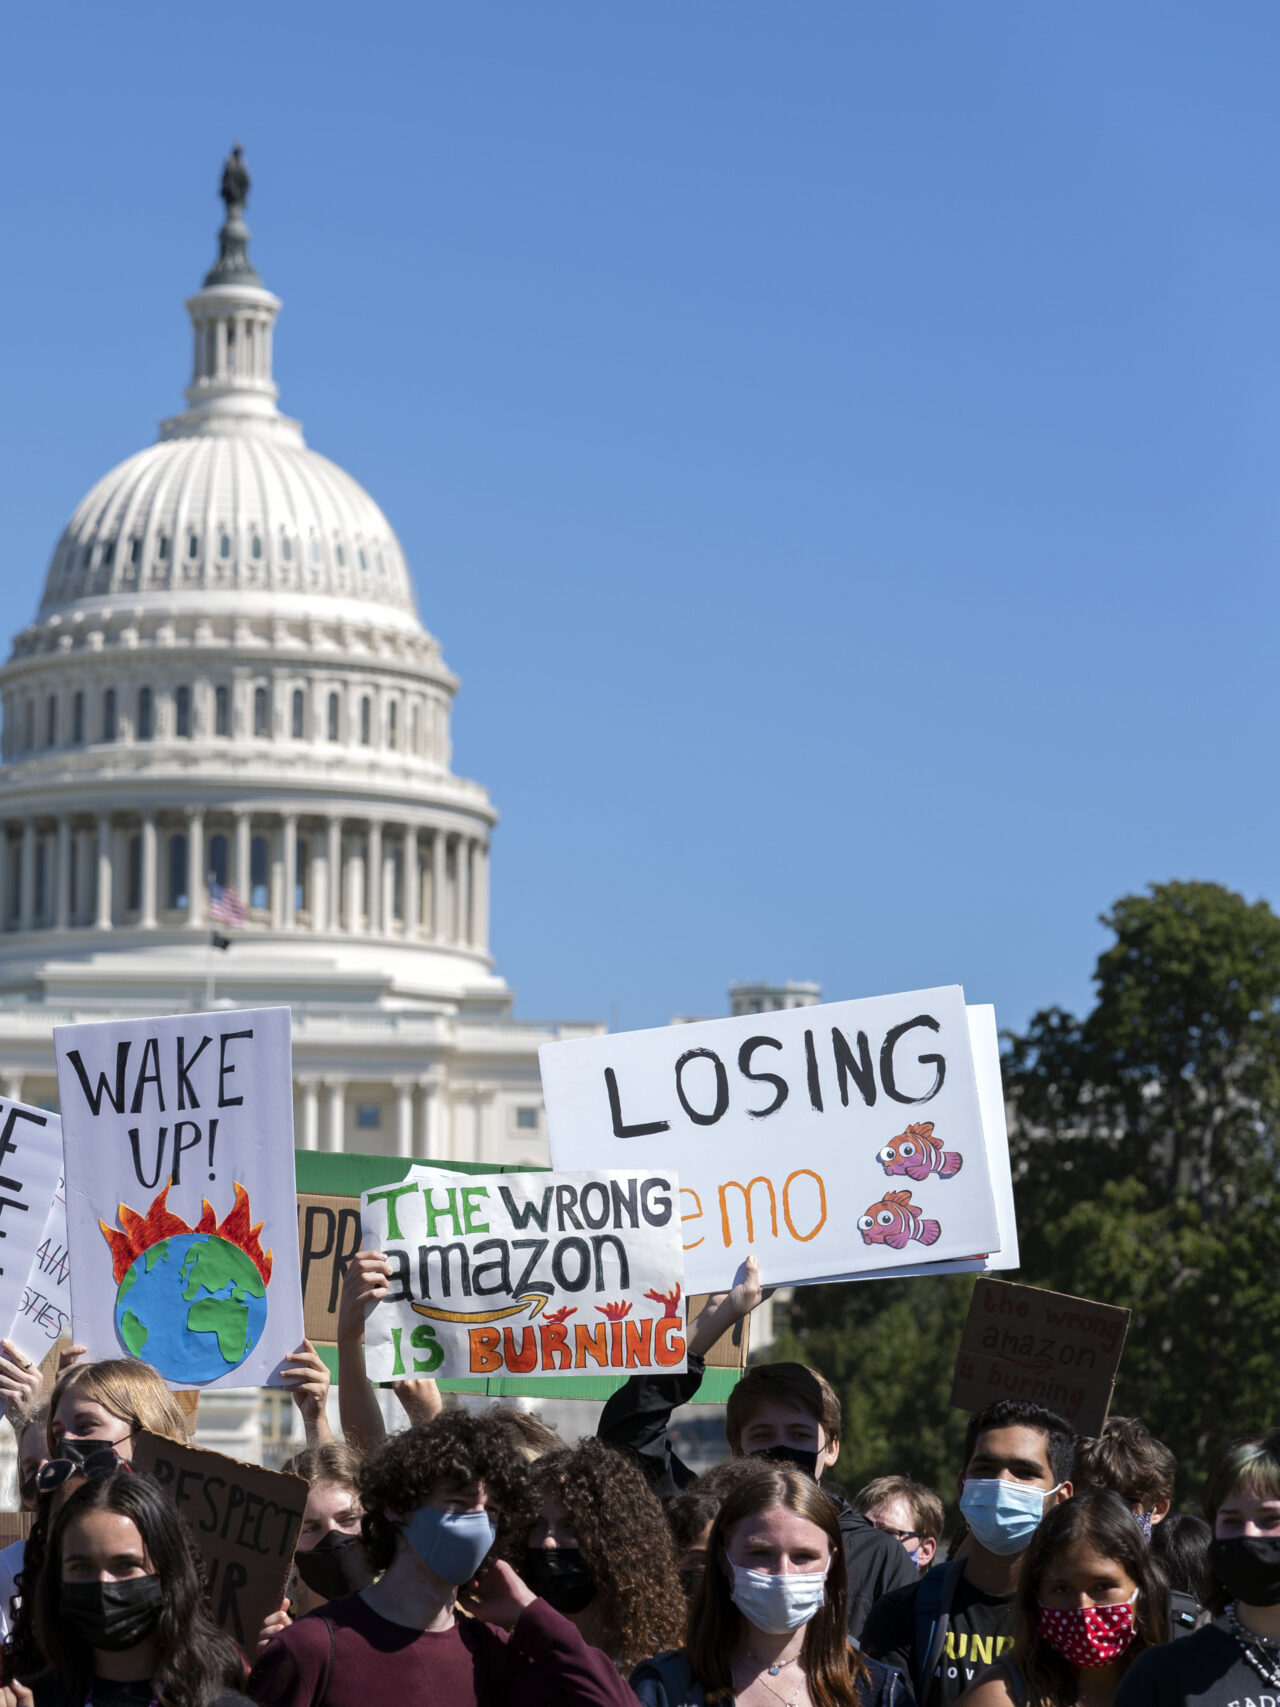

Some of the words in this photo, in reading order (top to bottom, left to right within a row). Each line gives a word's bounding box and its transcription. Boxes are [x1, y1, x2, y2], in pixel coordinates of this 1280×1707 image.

[66, 1029, 253, 1116] WAKE
[604, 1014, 947, 1139] LOSING
[128, 1119, 219, 1188] UP!
[366, 1182, 490, 1241] THE
[498, 1177, 672, 1233] WRONG
[380, 1233, 630, 1303] amazon
[391, 1323, 445, 1376] IS
[468, 1316, 686, 1375] BURNING
[981, 1325, 1098, 1370] amazon
[984, 1288, 1029, 1318] the
[1045, 1307, 1123, 1354] wrong
[958, 1356, 976, 1381] is
[986, 1362, 1087, 1420] burning
